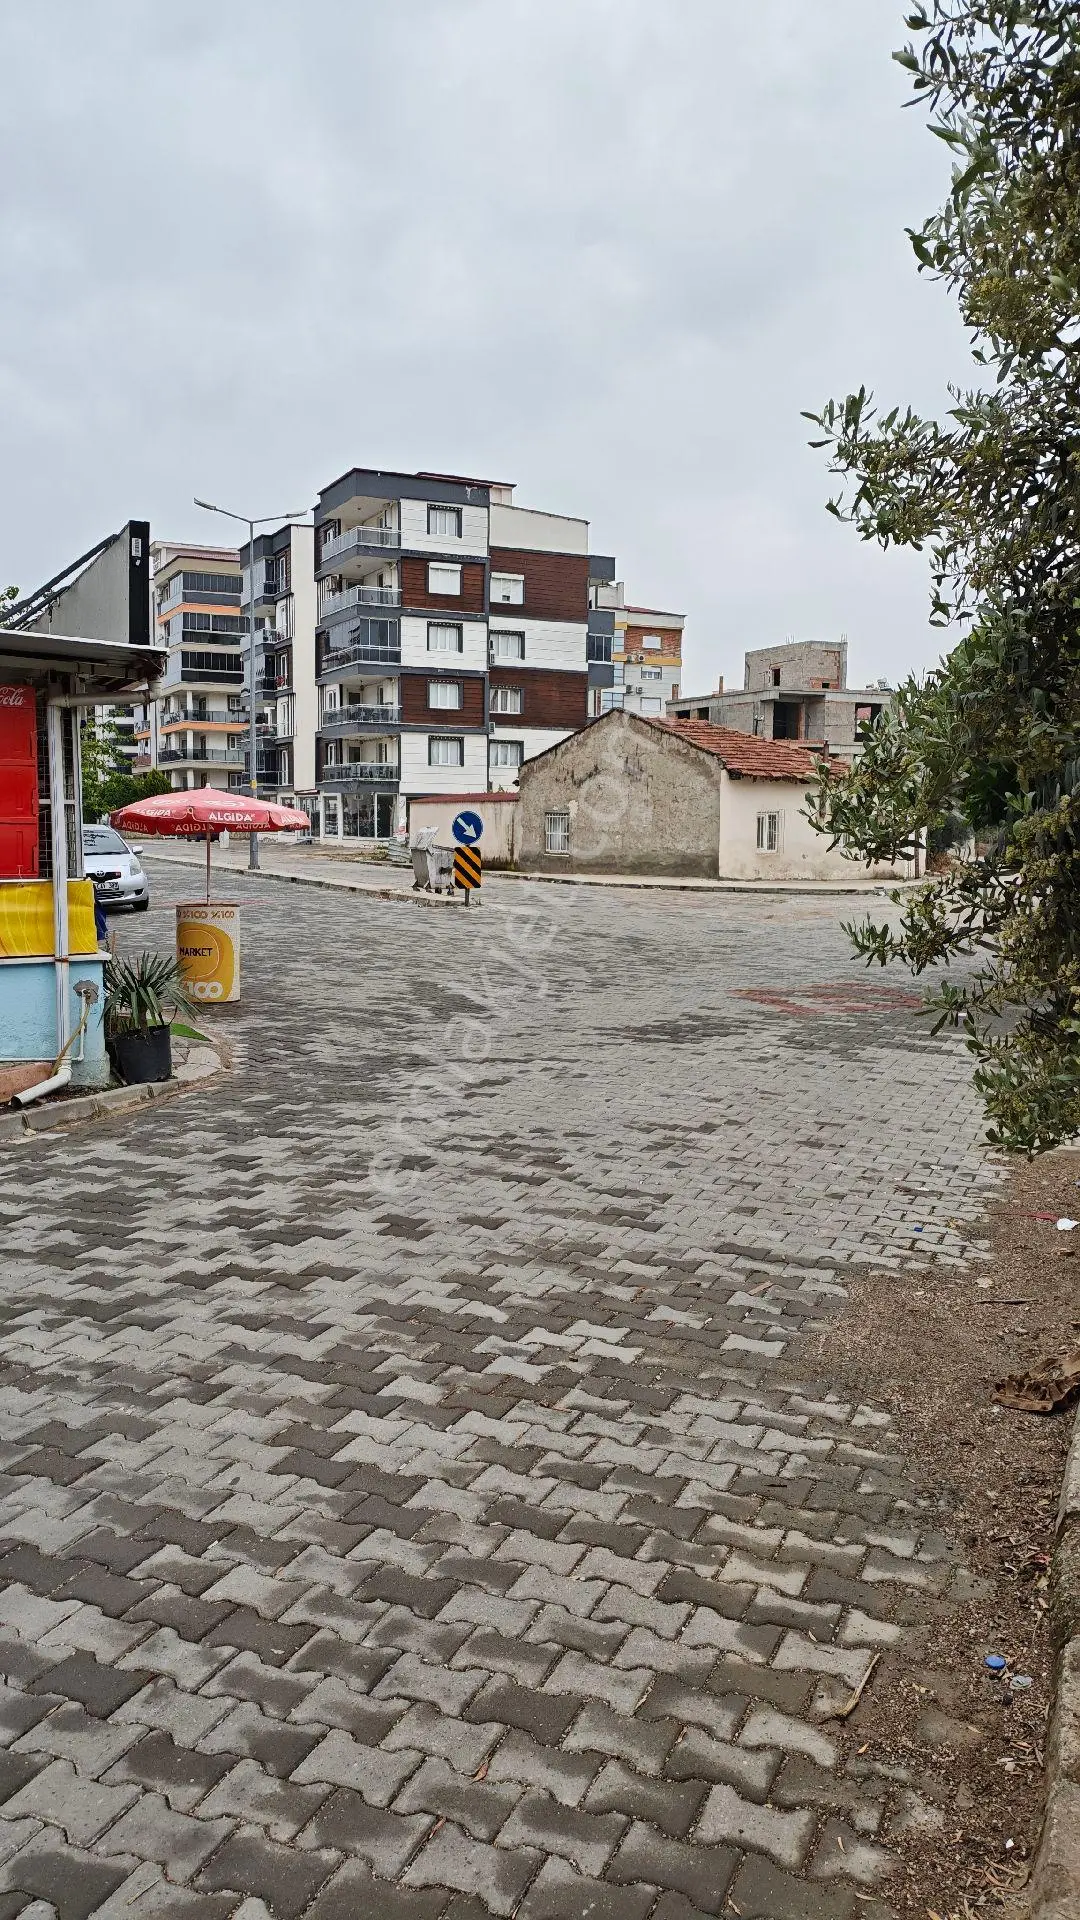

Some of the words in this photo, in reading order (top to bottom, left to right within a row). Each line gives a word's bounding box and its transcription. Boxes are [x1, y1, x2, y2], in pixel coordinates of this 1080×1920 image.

[209, 812, 253, 822] ALGIDA
[179, 947, 213, 957] MARKET
[185, 981, 223, 998] 100
